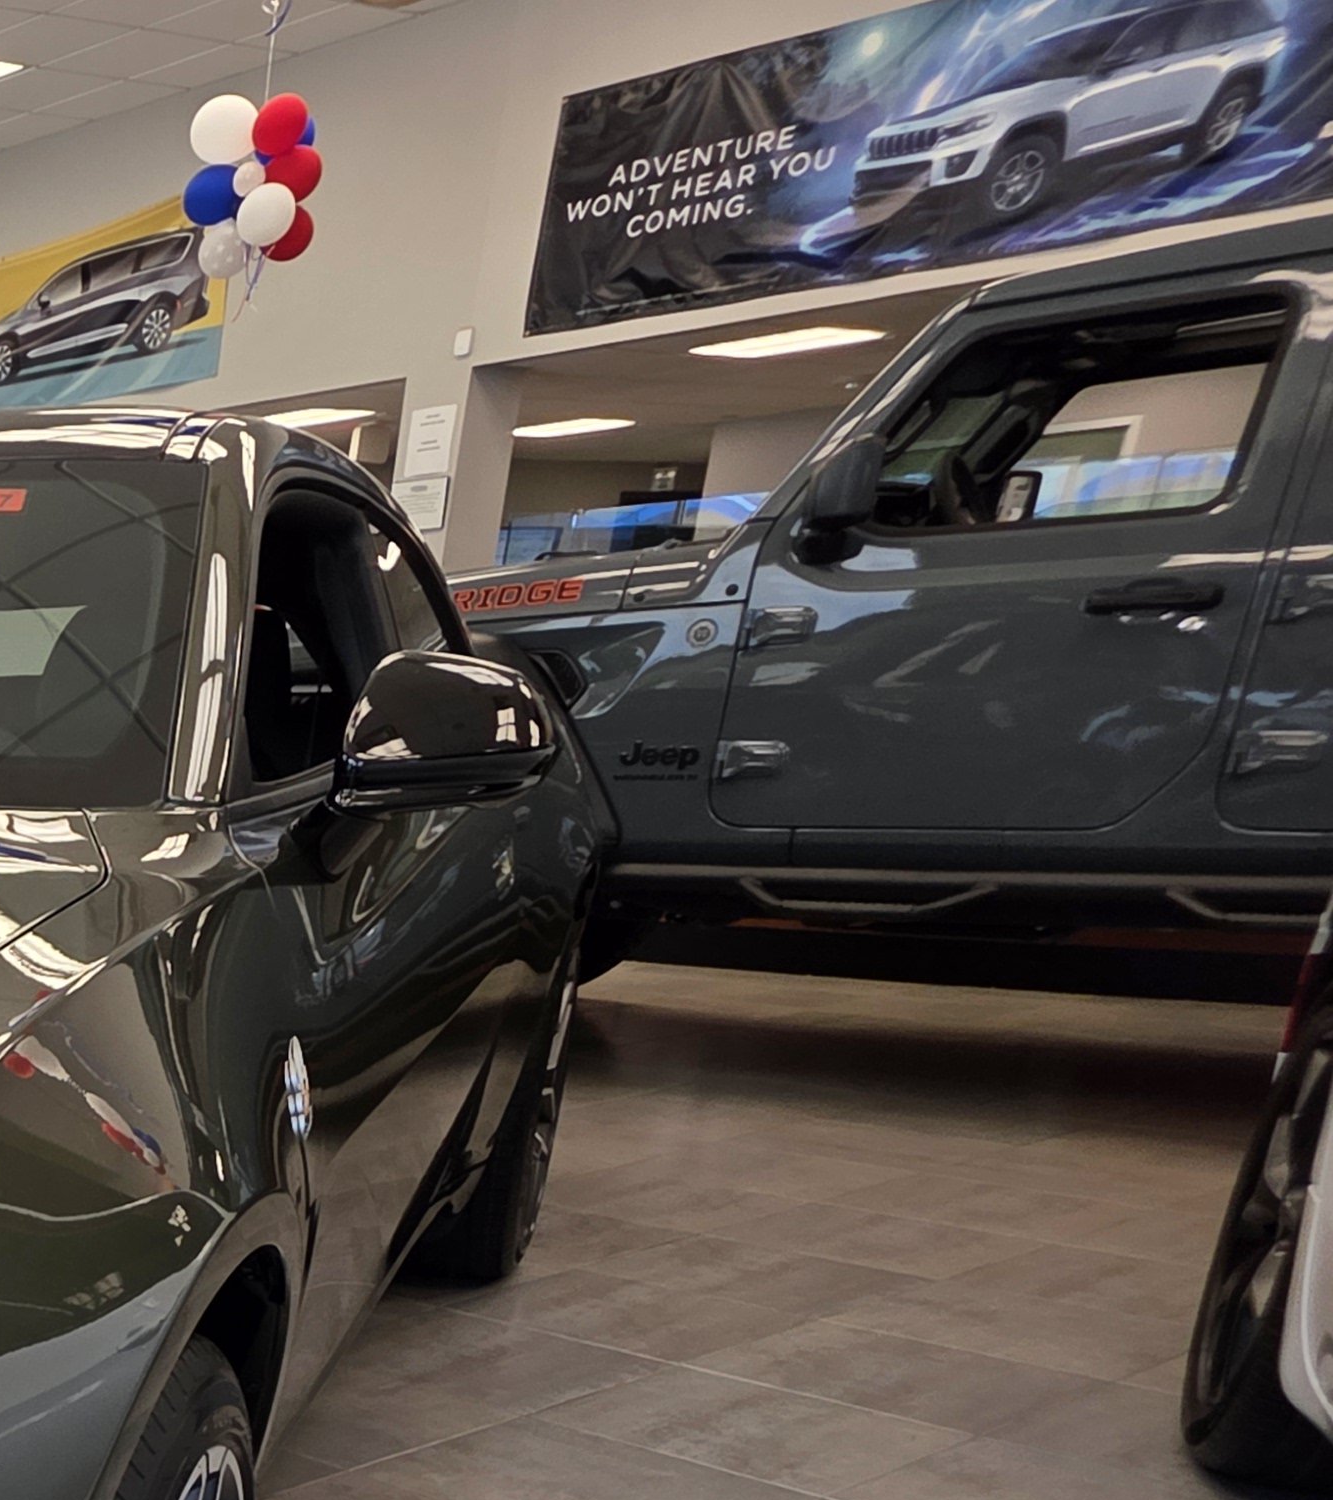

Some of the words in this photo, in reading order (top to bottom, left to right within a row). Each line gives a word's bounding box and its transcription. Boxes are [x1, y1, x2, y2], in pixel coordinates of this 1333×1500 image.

[607, 124, 798, 187] ADVENTURE
[566, 183, 663, 223] WON'T
[671, 163, 757, 201] HEAR
[769, 146, 837, 181] YOU
[626, 194, 754, 238] COMING.
[453, 576, 585, 612] RIDGE
[619, 739, 700, 770] Jeep
